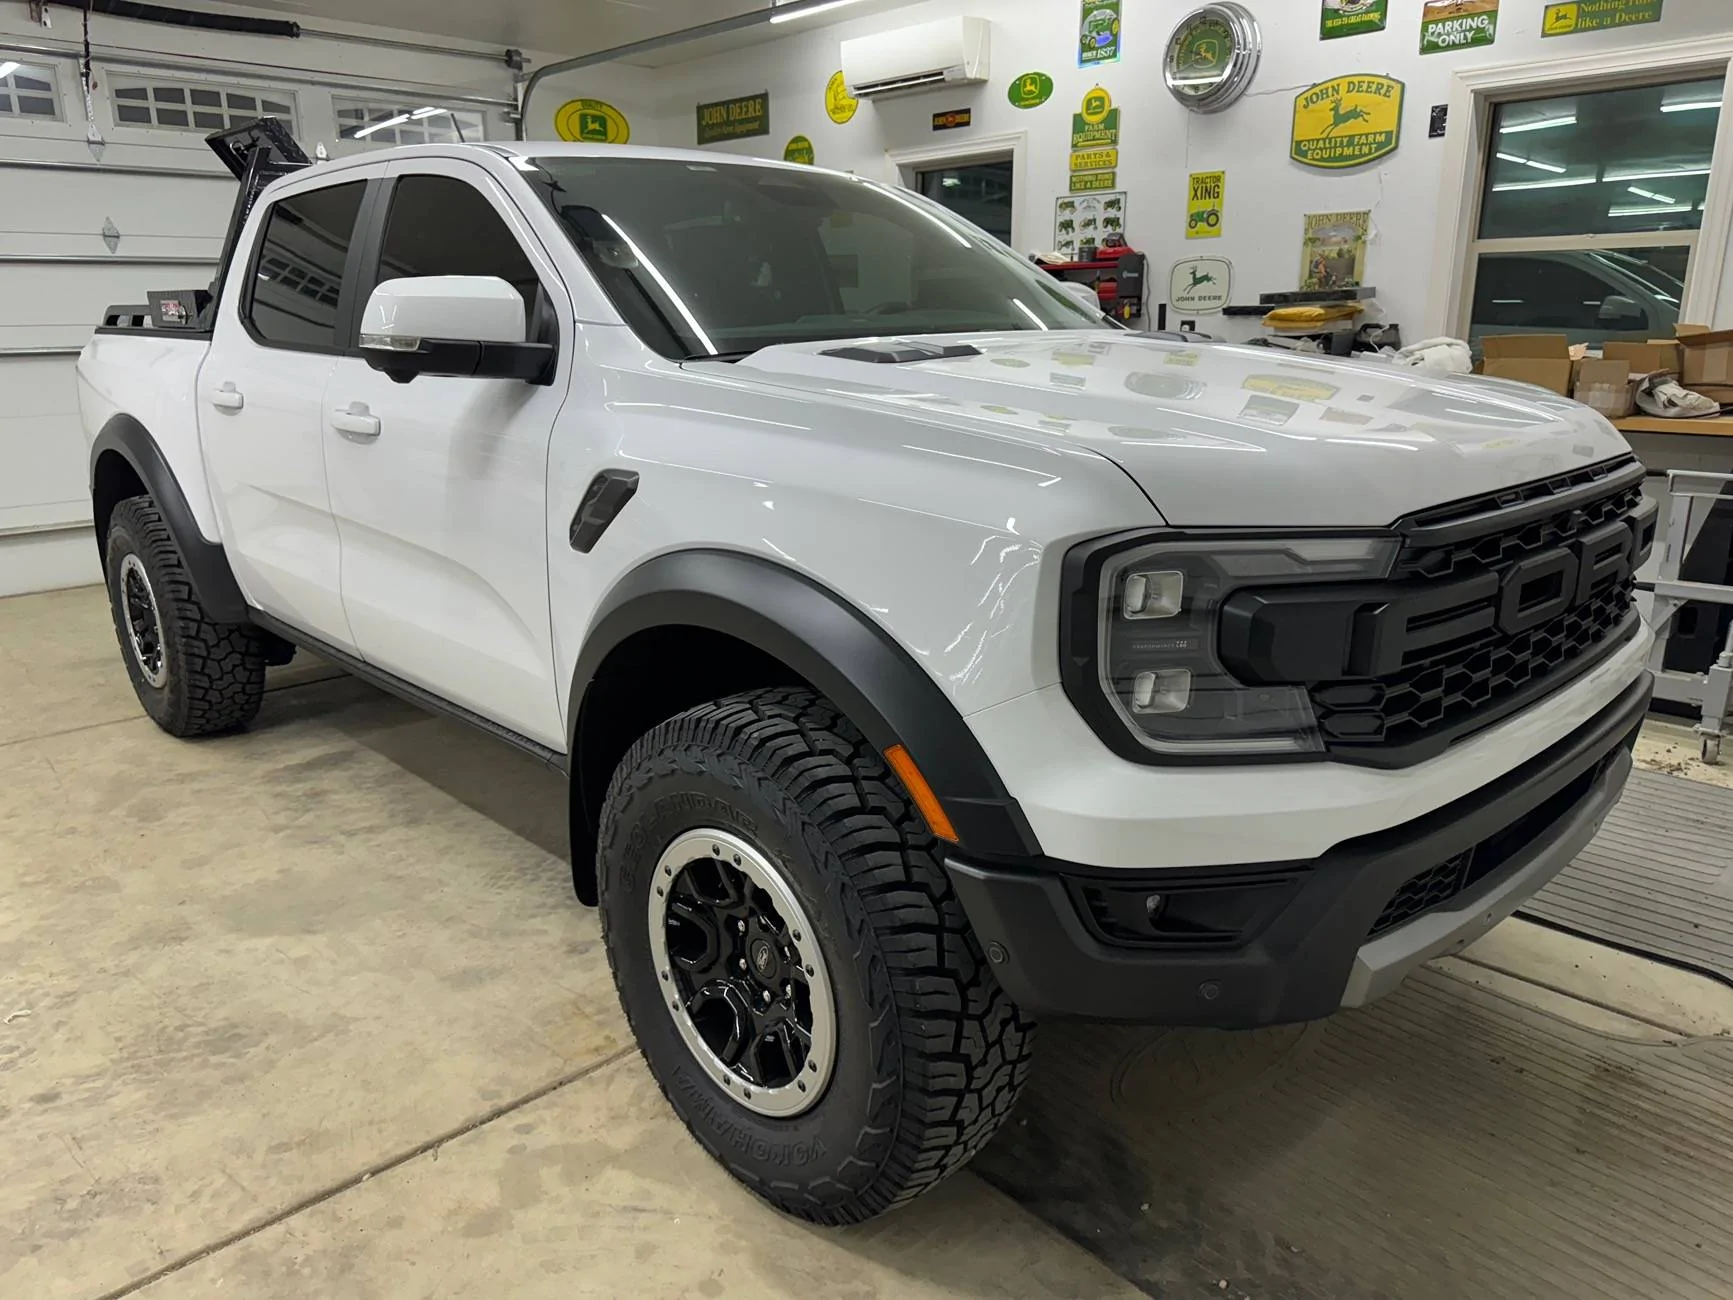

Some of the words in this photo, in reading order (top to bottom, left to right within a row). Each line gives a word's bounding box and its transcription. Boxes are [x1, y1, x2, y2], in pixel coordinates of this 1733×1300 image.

[1428, 15, 1489, 36] PARKING
[1578, 17, 1600, 29] like
[1603, 17, 1611, 25] a
[1615, 10, 1653, 24] Deere
[1438, 30, 1475, 47] ONLY
[1302, 83, 1341, 110] JOHN
[1346, 80, 1394, 98] DEERE
[702, 104, 728, 126] JOHN
[728, 98, 763, 120] DEERE
[1073, 129, 1117, 145] EQUIPMENT
[1300, 137, 1349, 150] QUALITY
[1353, 133, 1386, 145] FARM
[1075, 152, 1104, 161] PARTS
[1307, 144, 1377, 160] EQUIPMENT
[1073, 159, 1113, 169] SERVICES
[1192, 175, 1221, 186] TRACTOR
[1192, 183, 1220, 201] XING
[1175, 295, 1195, 303] JOHN
[1198, 294, 1223, 302] DEERE
[1373, 497, 1659, 678] FORD
